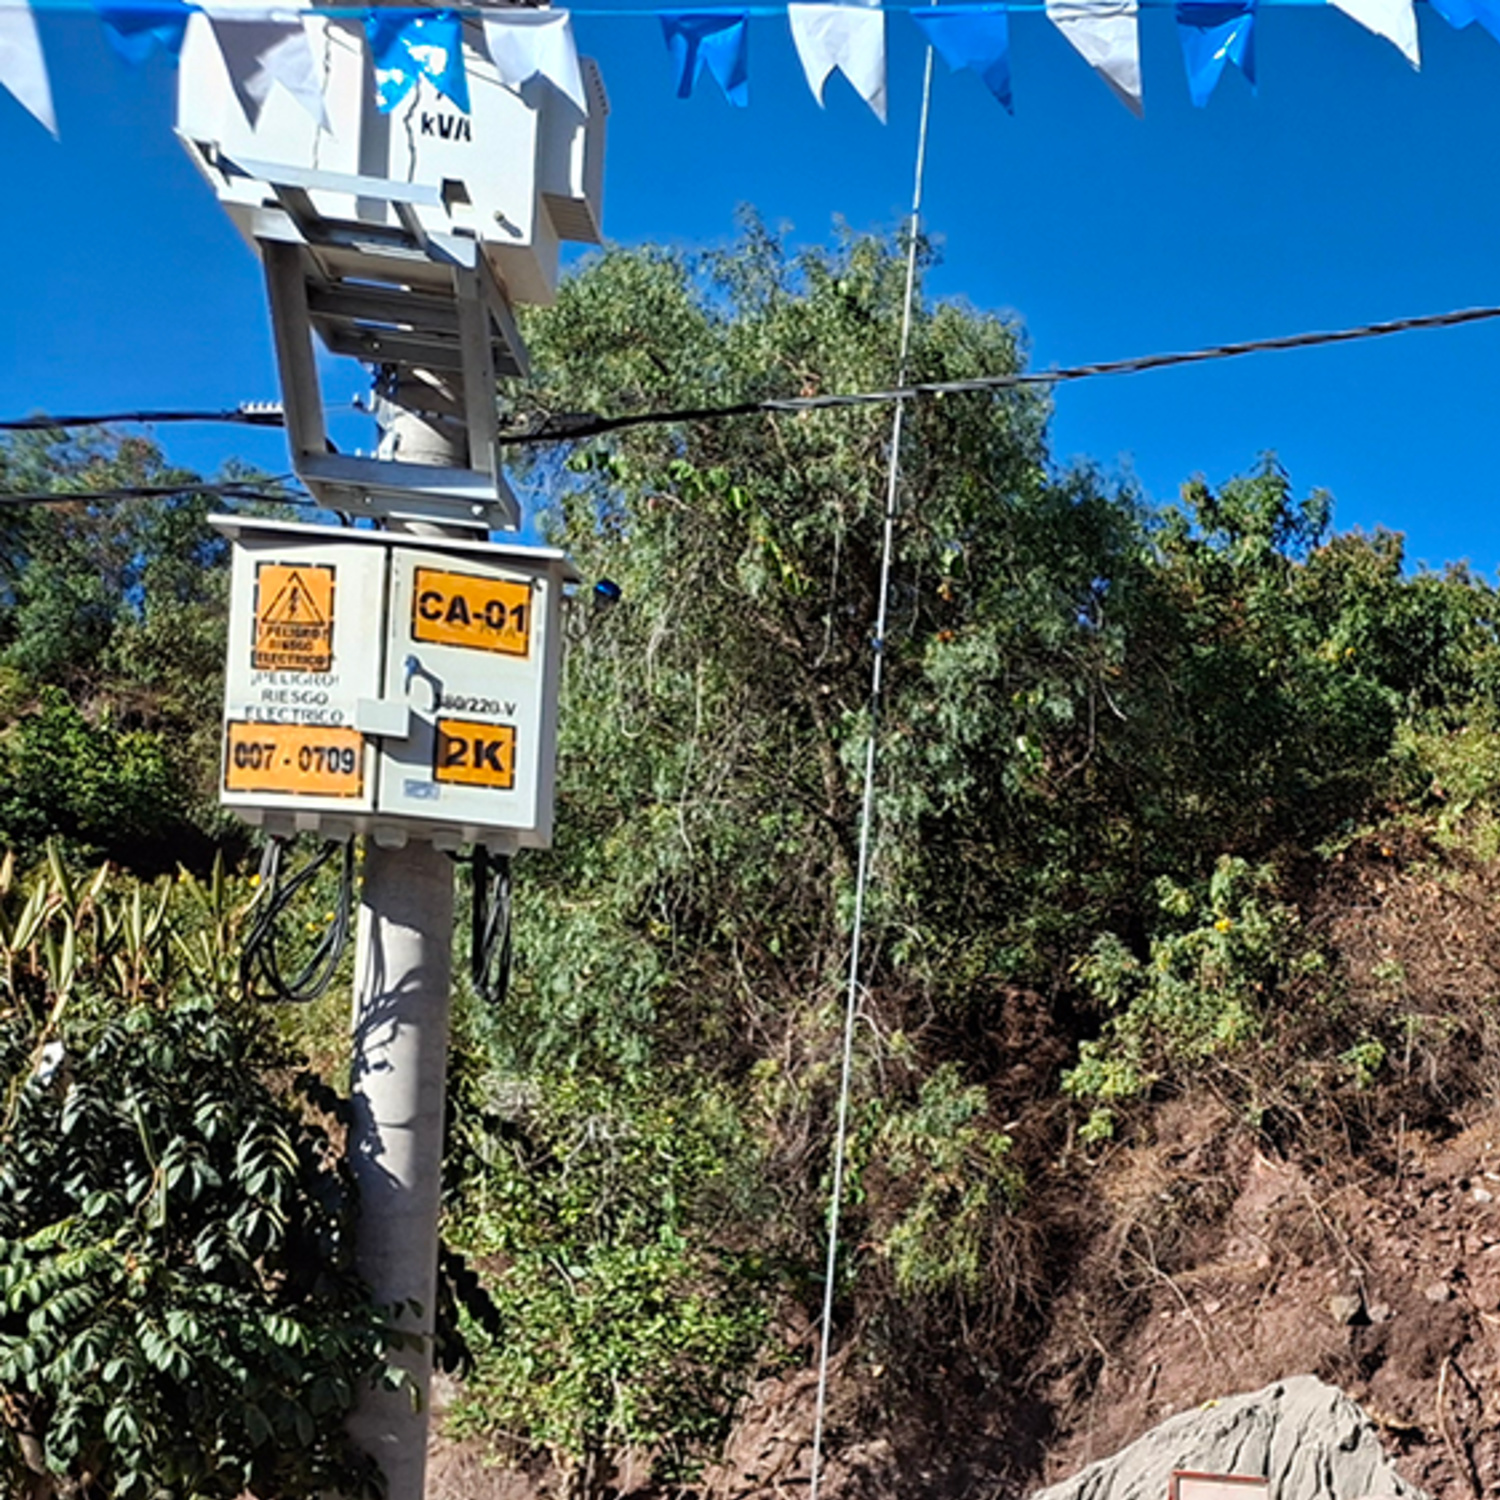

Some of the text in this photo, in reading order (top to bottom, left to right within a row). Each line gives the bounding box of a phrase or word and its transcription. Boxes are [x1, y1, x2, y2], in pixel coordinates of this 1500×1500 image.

[419, 591, 526, 633] CA-01
[261, 688, 330, 706] RIESGO
[234, 741, 277, 771] 007
[298, 745, 356, 776] 0709
[446, 737, 505, 773] 2K
